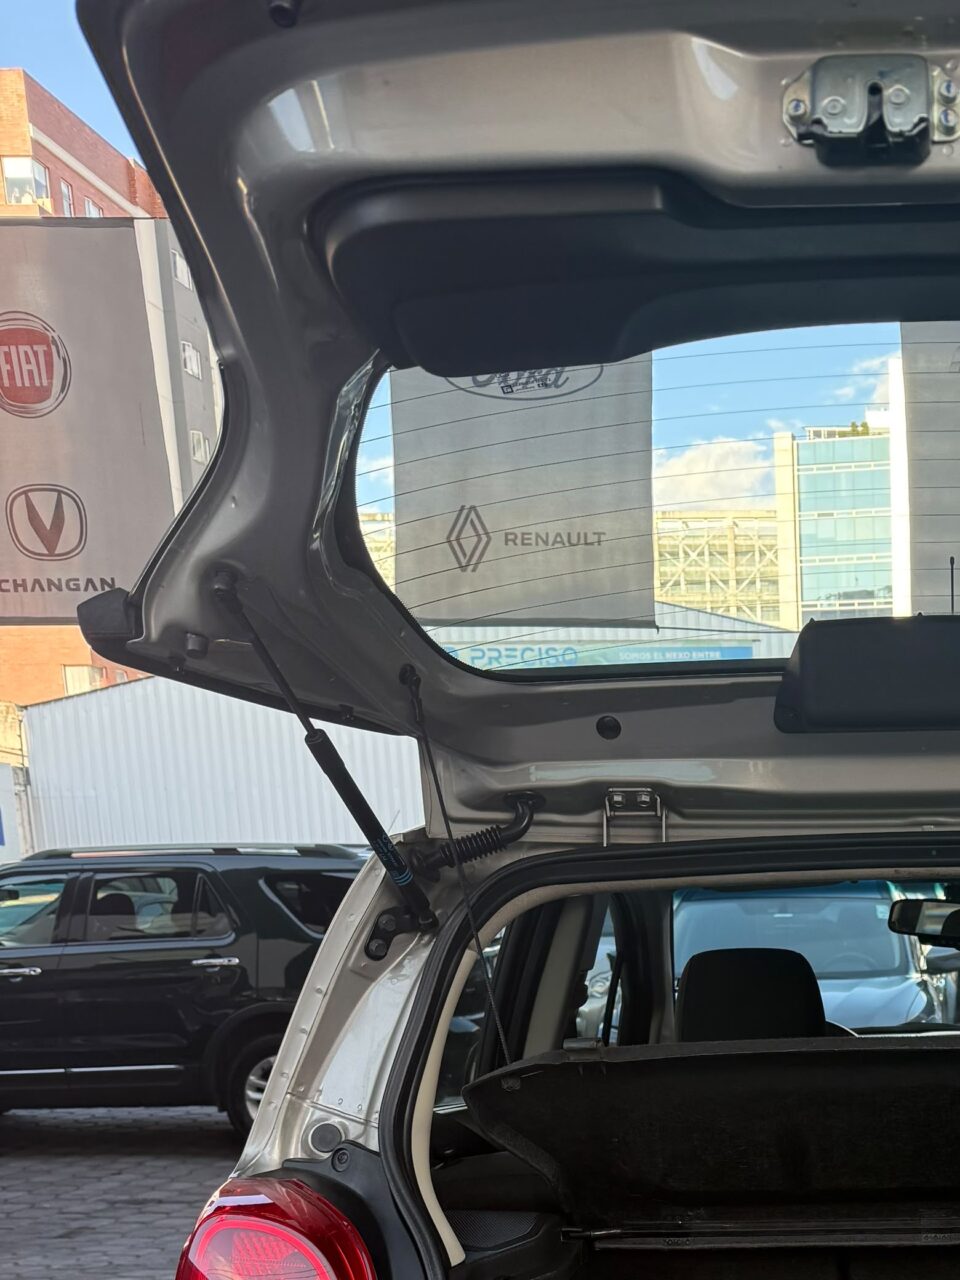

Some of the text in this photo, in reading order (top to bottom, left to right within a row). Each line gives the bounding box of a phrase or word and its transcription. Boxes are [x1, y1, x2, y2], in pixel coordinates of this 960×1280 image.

[0, 345, 48, 387] FIAT
[504, 531, 606, 547] RENAULT
[0, 577, 116, 592] CHANGAN
[470, 646, 578, 666] PRECISO
